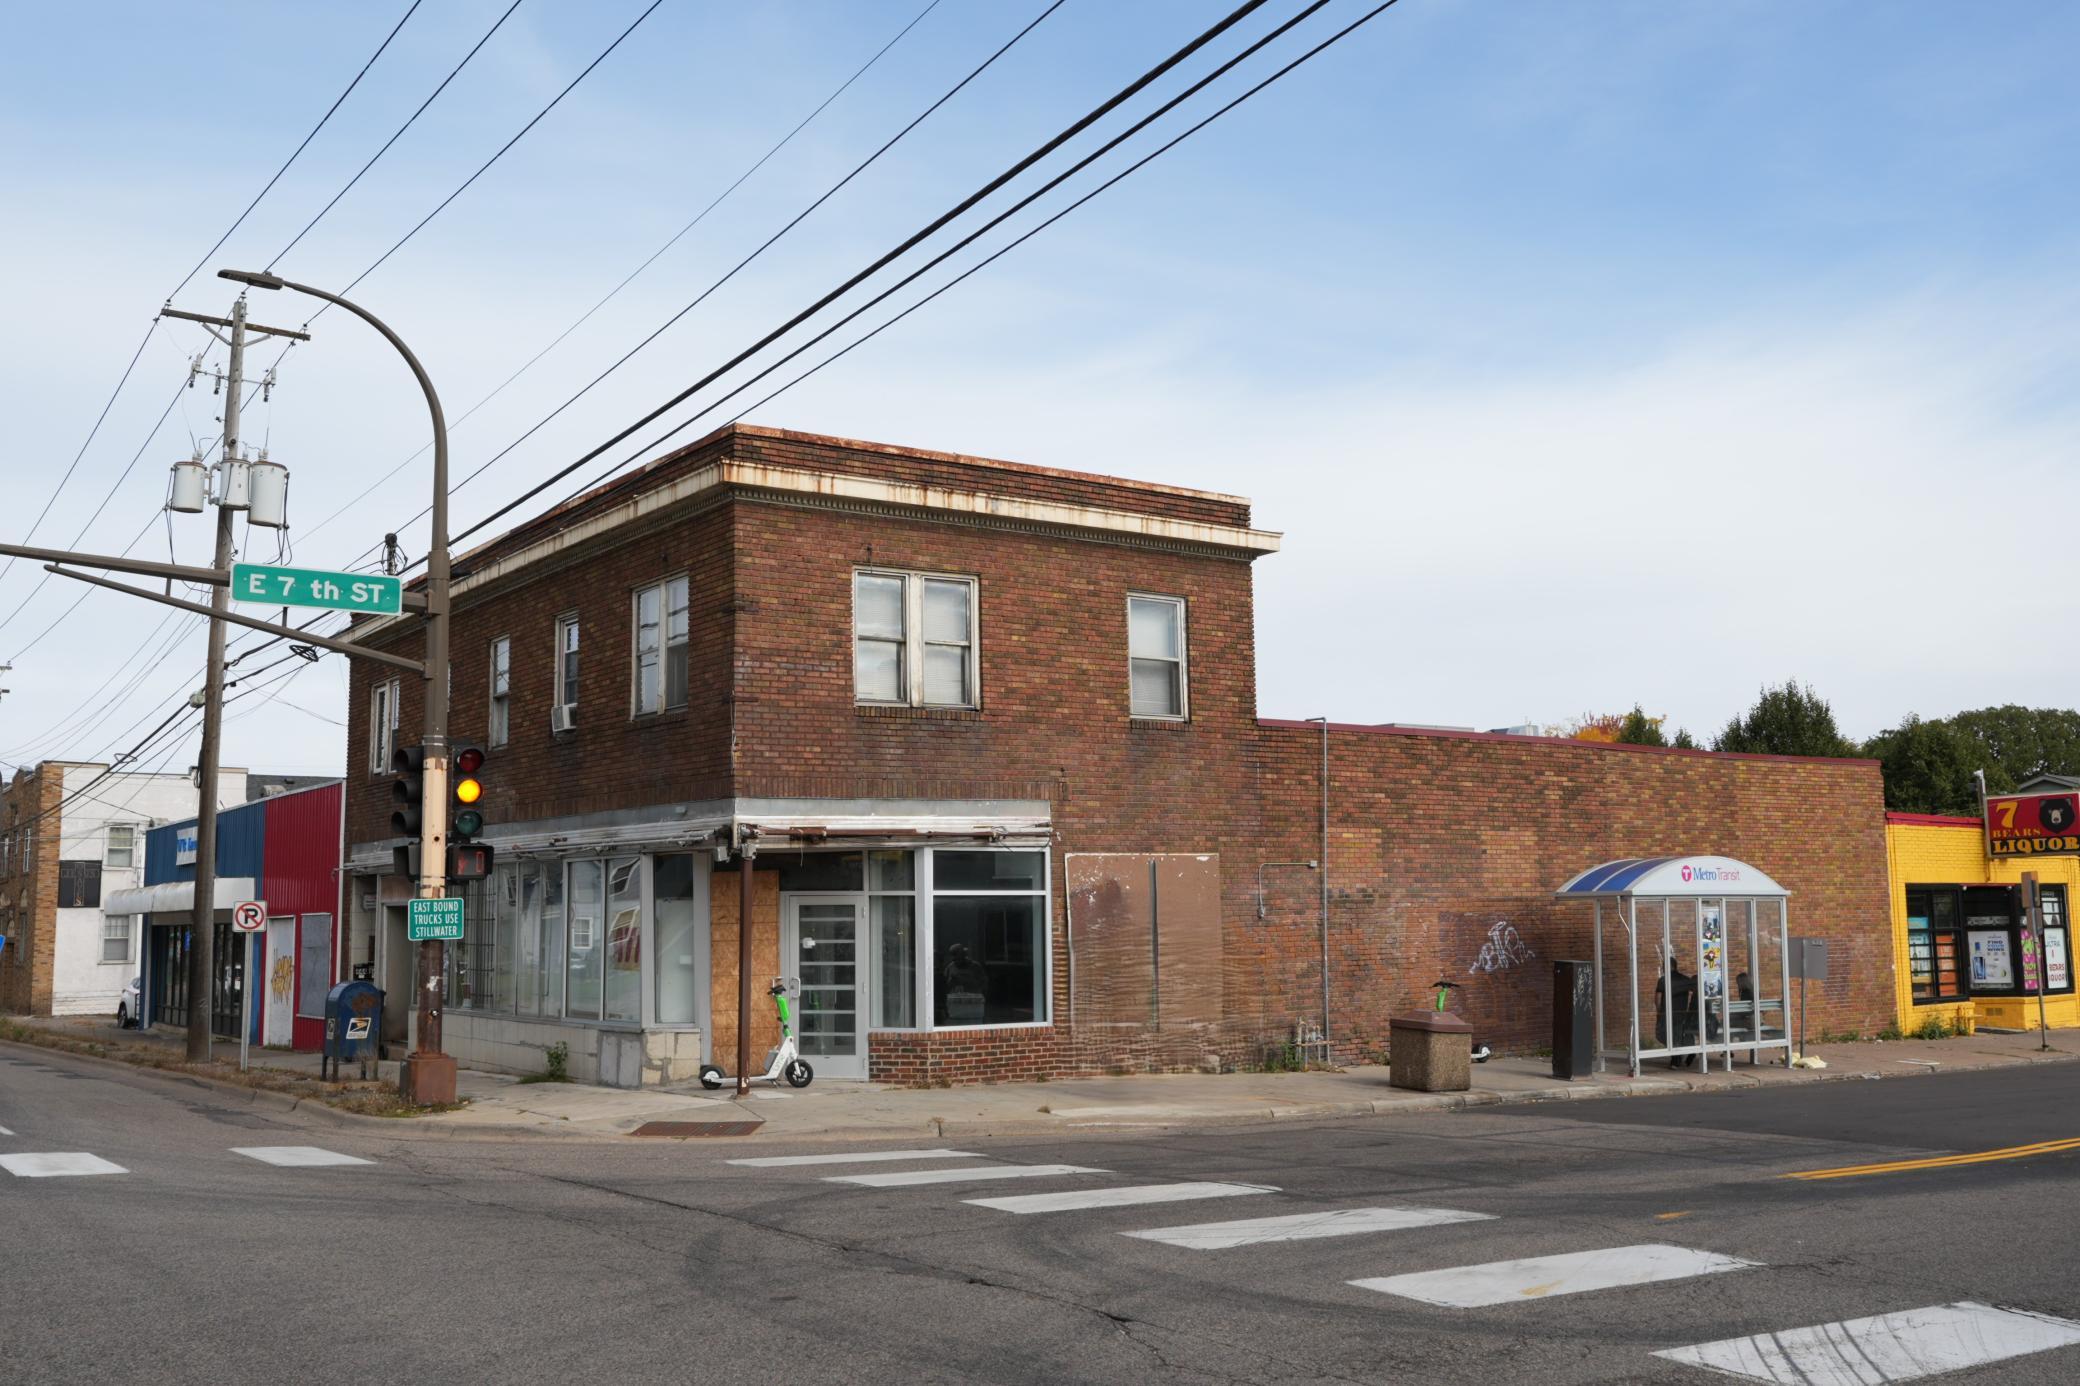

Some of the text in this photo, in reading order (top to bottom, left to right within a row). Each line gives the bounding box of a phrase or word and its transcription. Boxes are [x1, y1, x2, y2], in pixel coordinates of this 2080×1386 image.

[249, 573, 385, 604] E 7 th ST
[1995, 801, 2018, 829] 7
[1992, 828, 2042, 838] BEARS
[1992, 836, 2080, 854] LIQUOR
[413, 901, 459, 913] EAST BOUND
[414, 914, 459, 925] TRUCKS USE
[415, 926, 457, 937] STILLWATER
